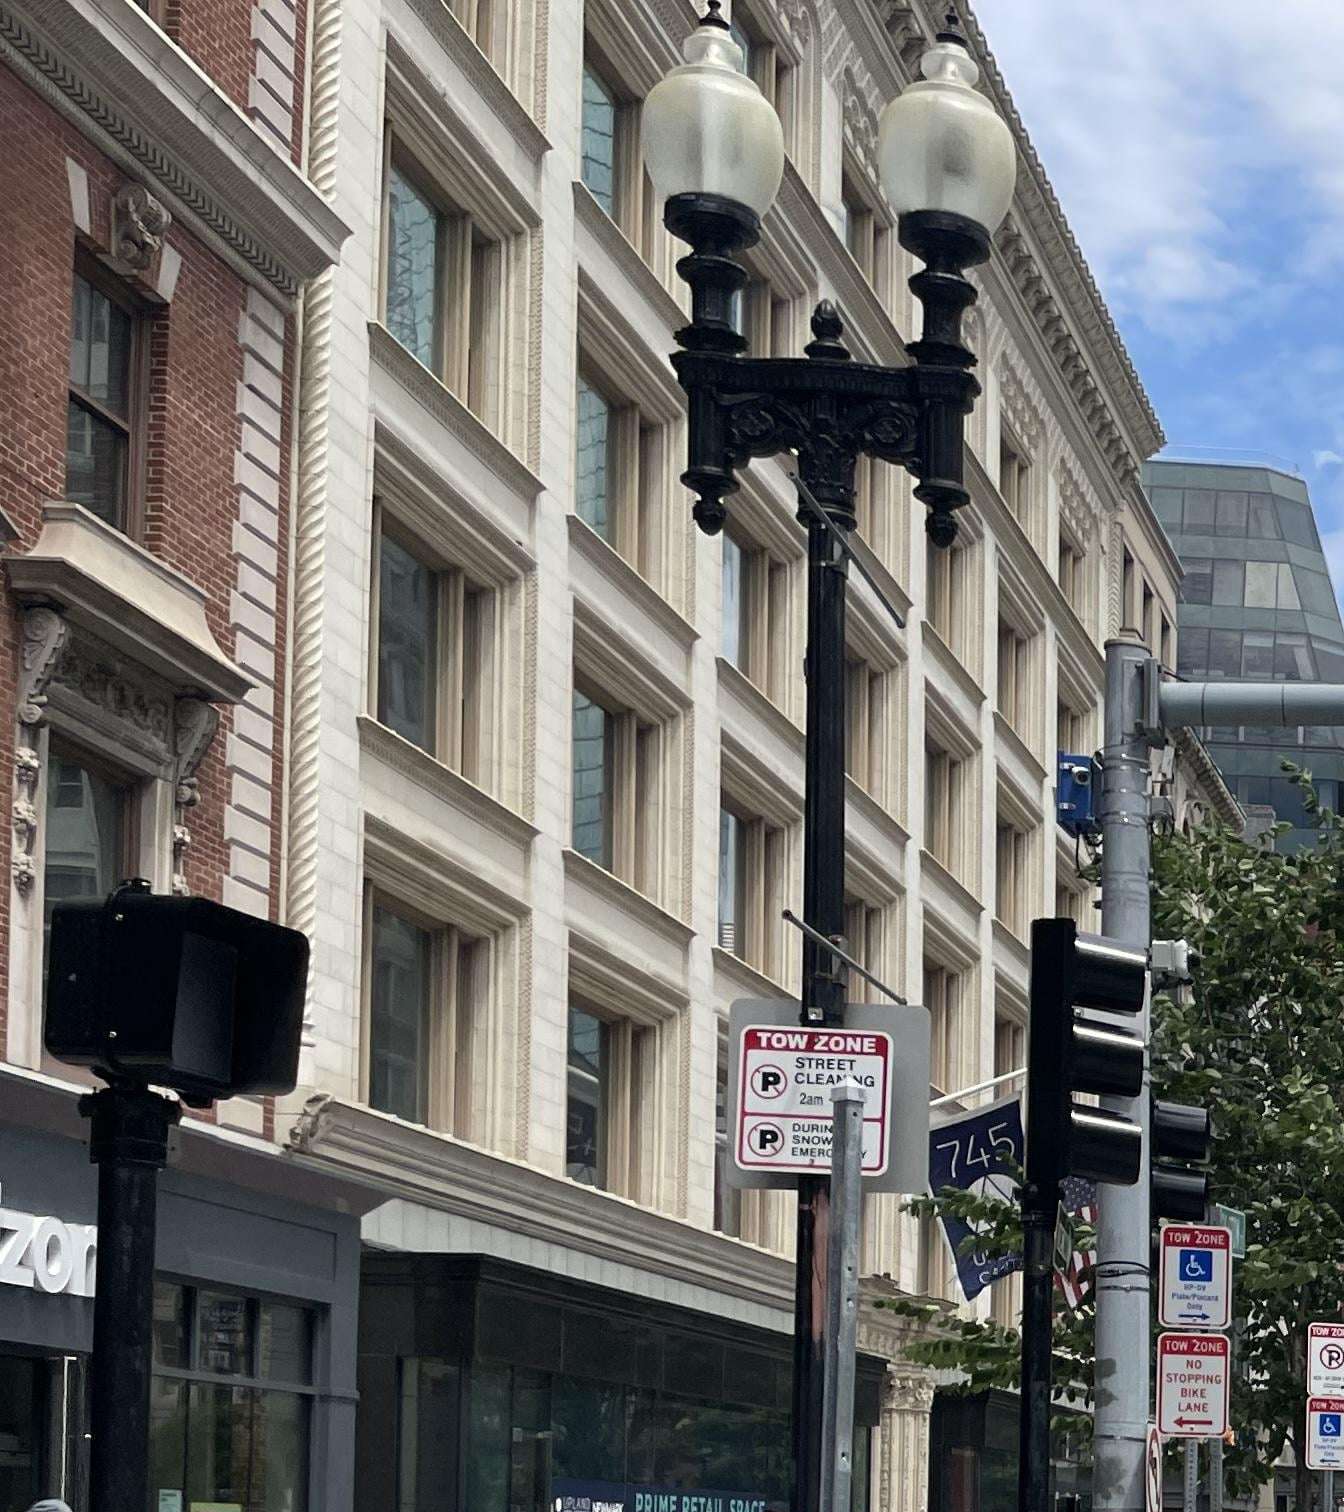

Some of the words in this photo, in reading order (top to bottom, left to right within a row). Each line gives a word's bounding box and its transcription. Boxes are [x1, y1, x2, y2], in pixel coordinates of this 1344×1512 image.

[757, 1032, 808, 1049] TOW
[814, 1036, 876, 1053] ZONE
[796, 1057, 856, 1071] STREET
[794, 1073, 875, 1088] CLEANNG
[800, 1092, 824, 1106] 2am
[792, 1122, 833, 1133] DURIN
[936, 1122, 1015, 1178] 745
[1168, 1231, 1191, 1243] TOW
[1195, 1232, 1225, 1245] ZONE
[1166, 1340, 1188, 1351] TOW
[1193, 1340, 1224, 1353] ZONE
[1186, 1360, 1202, 1369] NO
[1166, 1373, 1222, 1385] STOPPING
[1180, 1388, 1207, 1399] BIKE
[1178, 1402, 1208, 1413] LANE
